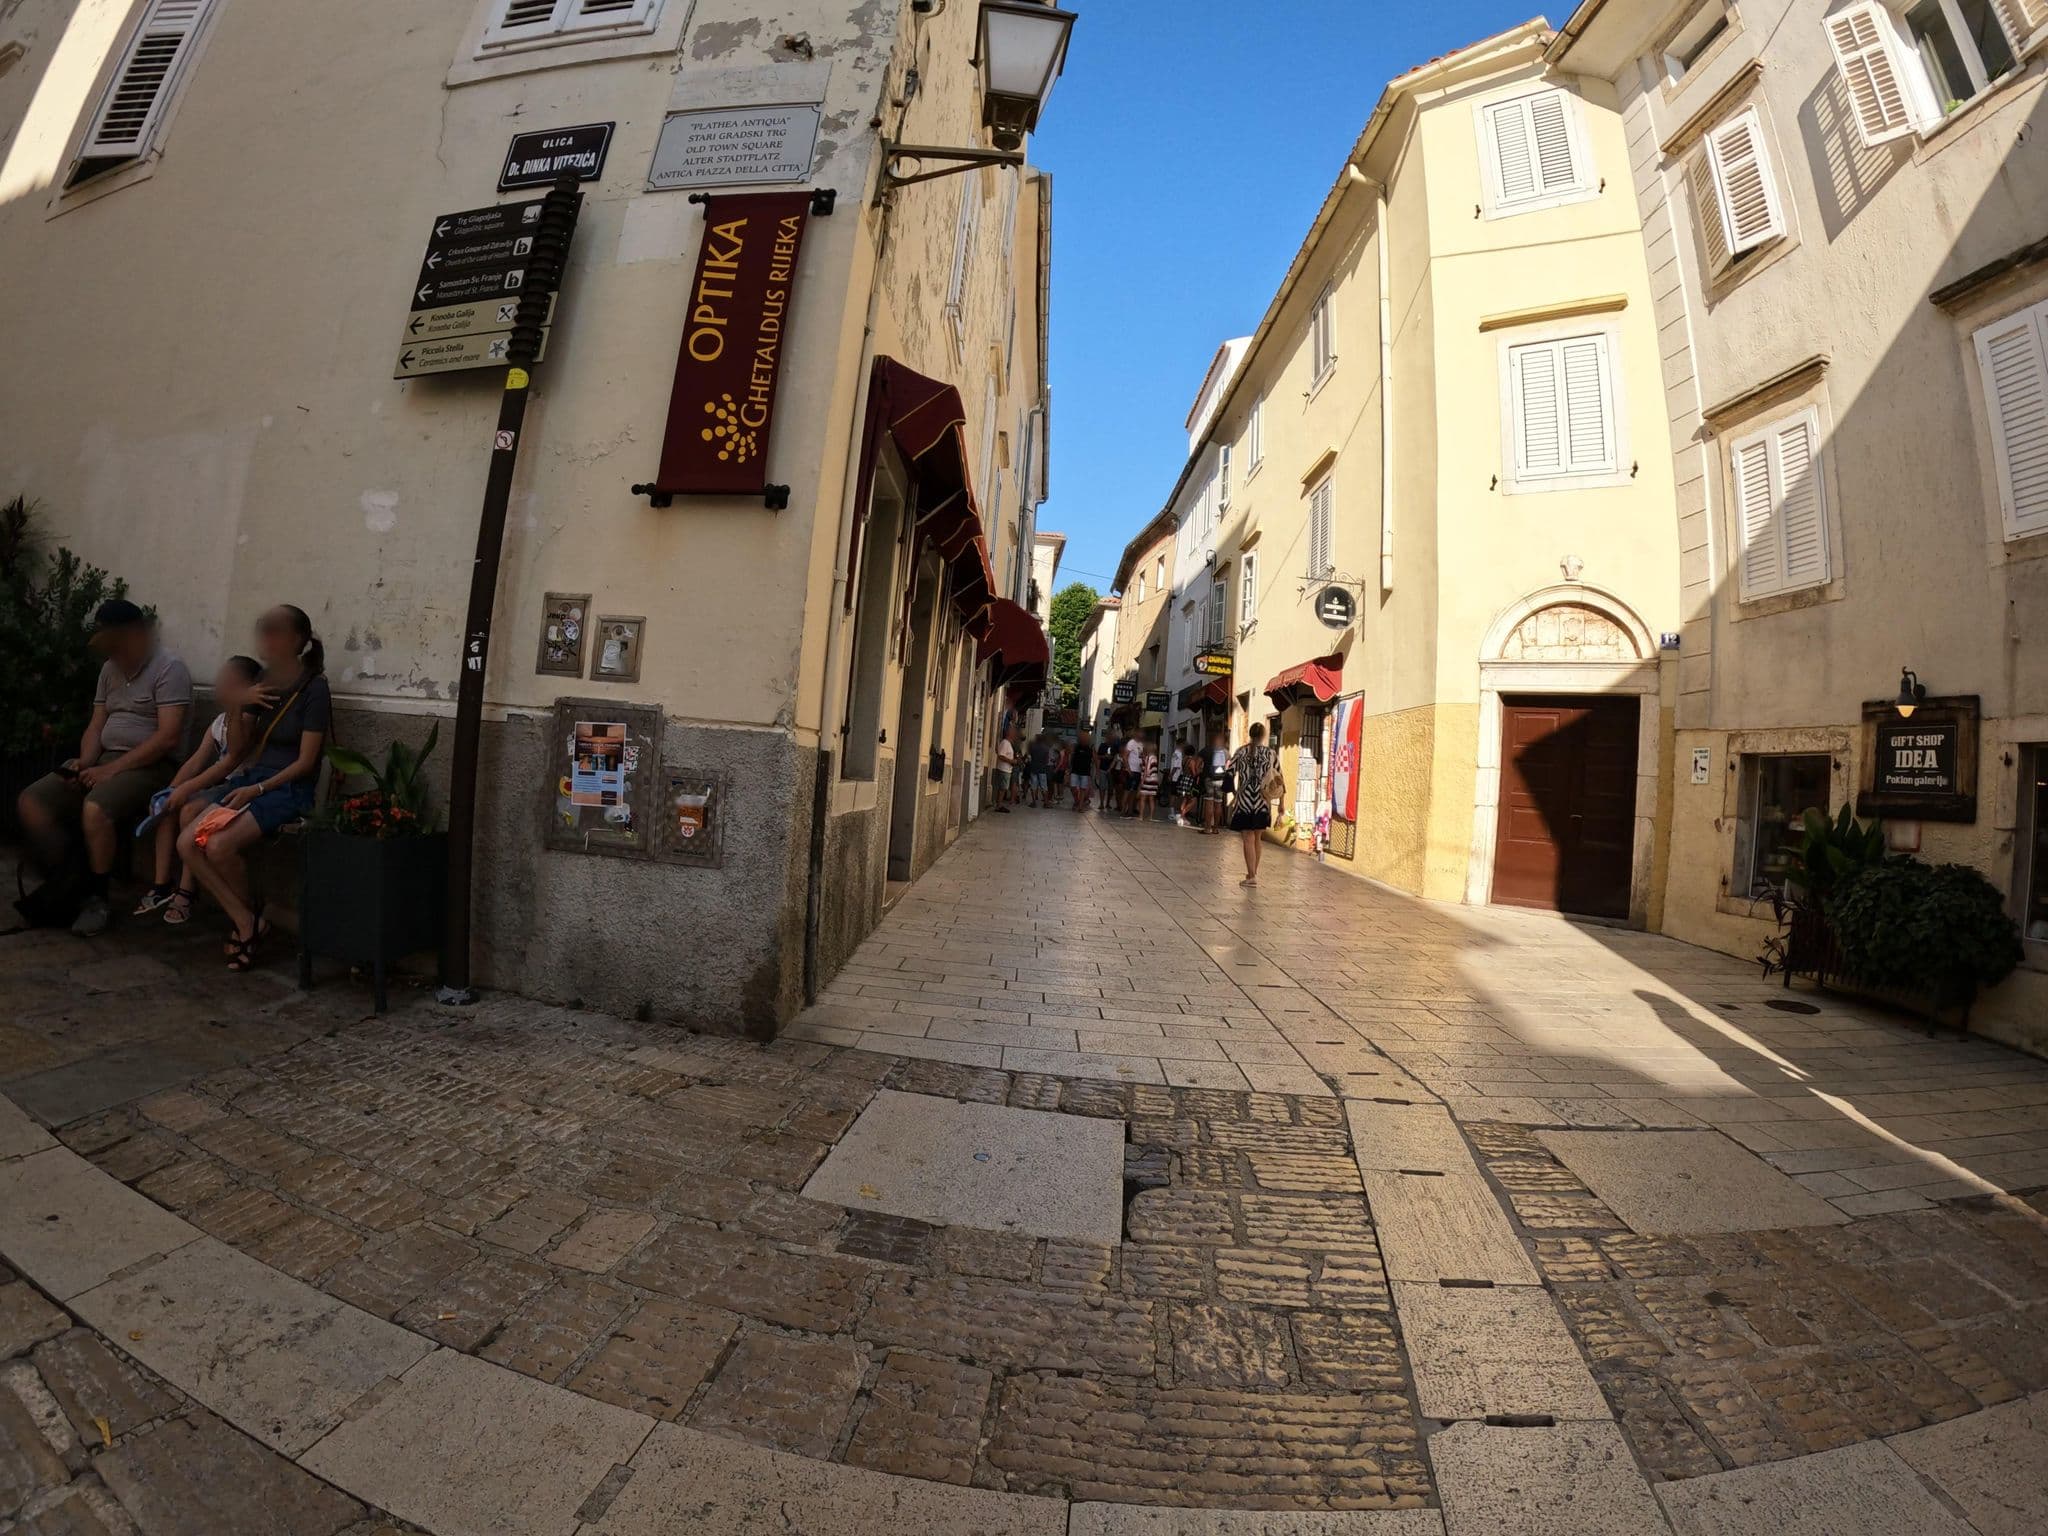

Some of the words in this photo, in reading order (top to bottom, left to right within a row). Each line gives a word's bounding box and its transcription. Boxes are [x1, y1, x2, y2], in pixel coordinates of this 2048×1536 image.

[688, 134, 716, 142] STARI
[718, 131, 763, 140] GRADSKI
[767, 129, 787, 137] TRG
[542, 136, 573, 149] ULICA
[686, 146, 706, 154] OLD
[709, 143, 739, 152] TOWN
[742, 140, 783, 150] SQUARE
[522, 157, 551, 175] DINKA
[682, 156, 713, 166] ALTER
[716, 153, 780, 163] STADTPLATZ
[656, 170, 692, 180] ANTICA
[695, 167, 732, 176] PIAZZA
[735, 165, 768, 174] DELLA
[688, 217, 748, 362] OPTIKA
[740, 289, 785, 427] GHETALDUS
[769, 215, 800, 282] RIJEKA
[1664, 632, 1677, 644] 12
[1891, 735, 1915, 747] GIFT
[1916, 734, 1945, 746] SHOP
[1895, 750, 1939, 768] IDEA
[1886, 775, 1913, 784] Poklon
